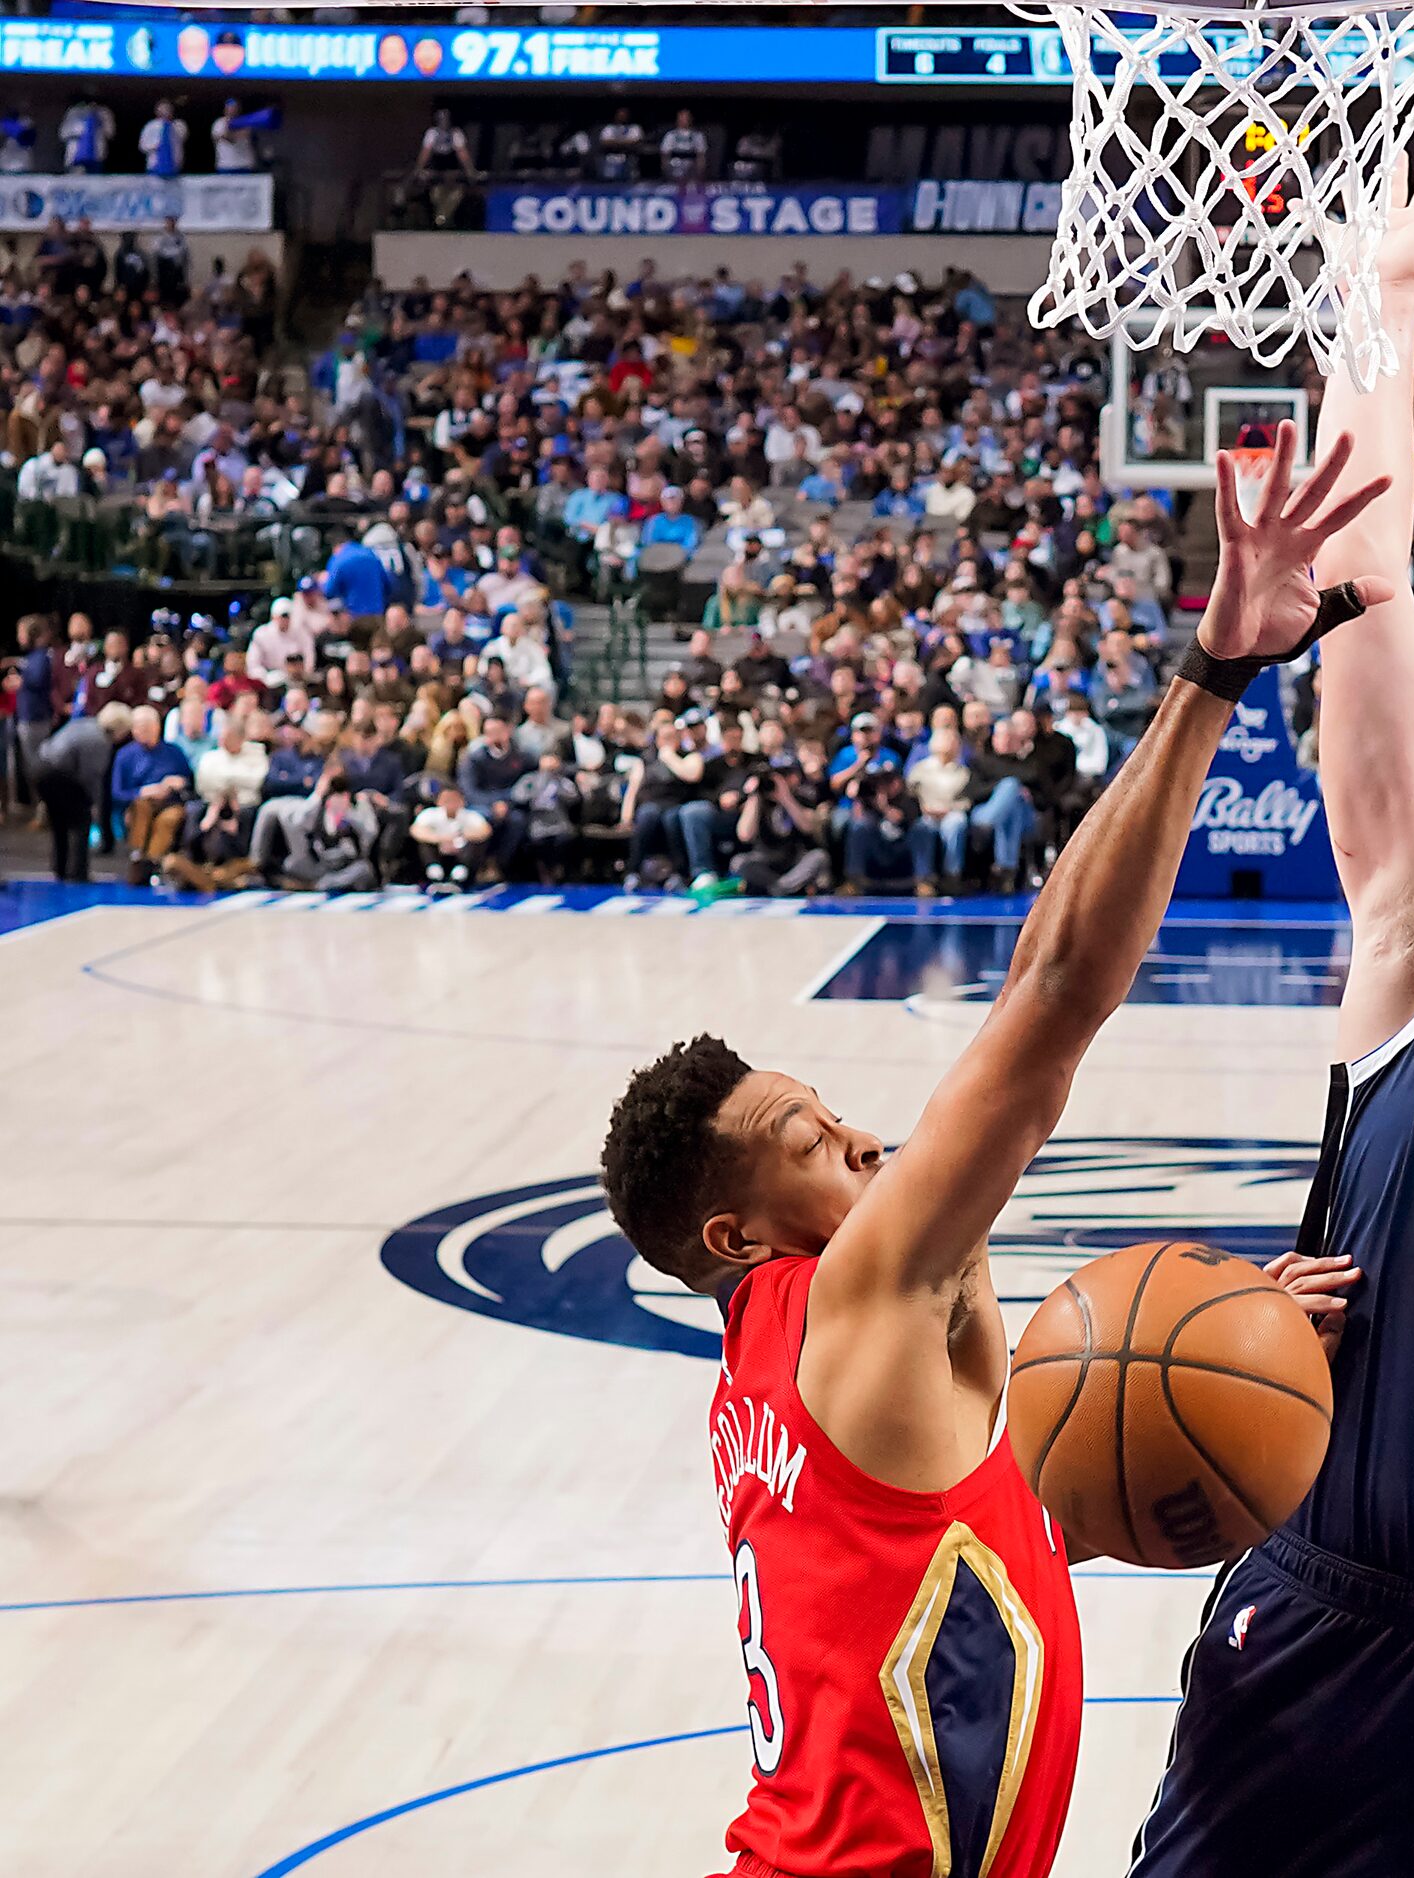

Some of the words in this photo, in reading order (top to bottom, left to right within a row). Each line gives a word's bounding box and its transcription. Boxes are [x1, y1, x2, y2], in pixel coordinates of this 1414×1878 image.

[3, 38, 114, 69] FREAK
[451, 31, 550, 76] 97.1
[552, 47, 660, 76] FREAK
[985, 52, 1007, 75] 4
[511, 196, 678, 233] SOUND
[710, 196, 878, 233] STAGE
[1190, 776, 1321, 846] Bally
[1207, 829, 1286, 856] SPORTS
[734, 1538, 786, 1778] 3
